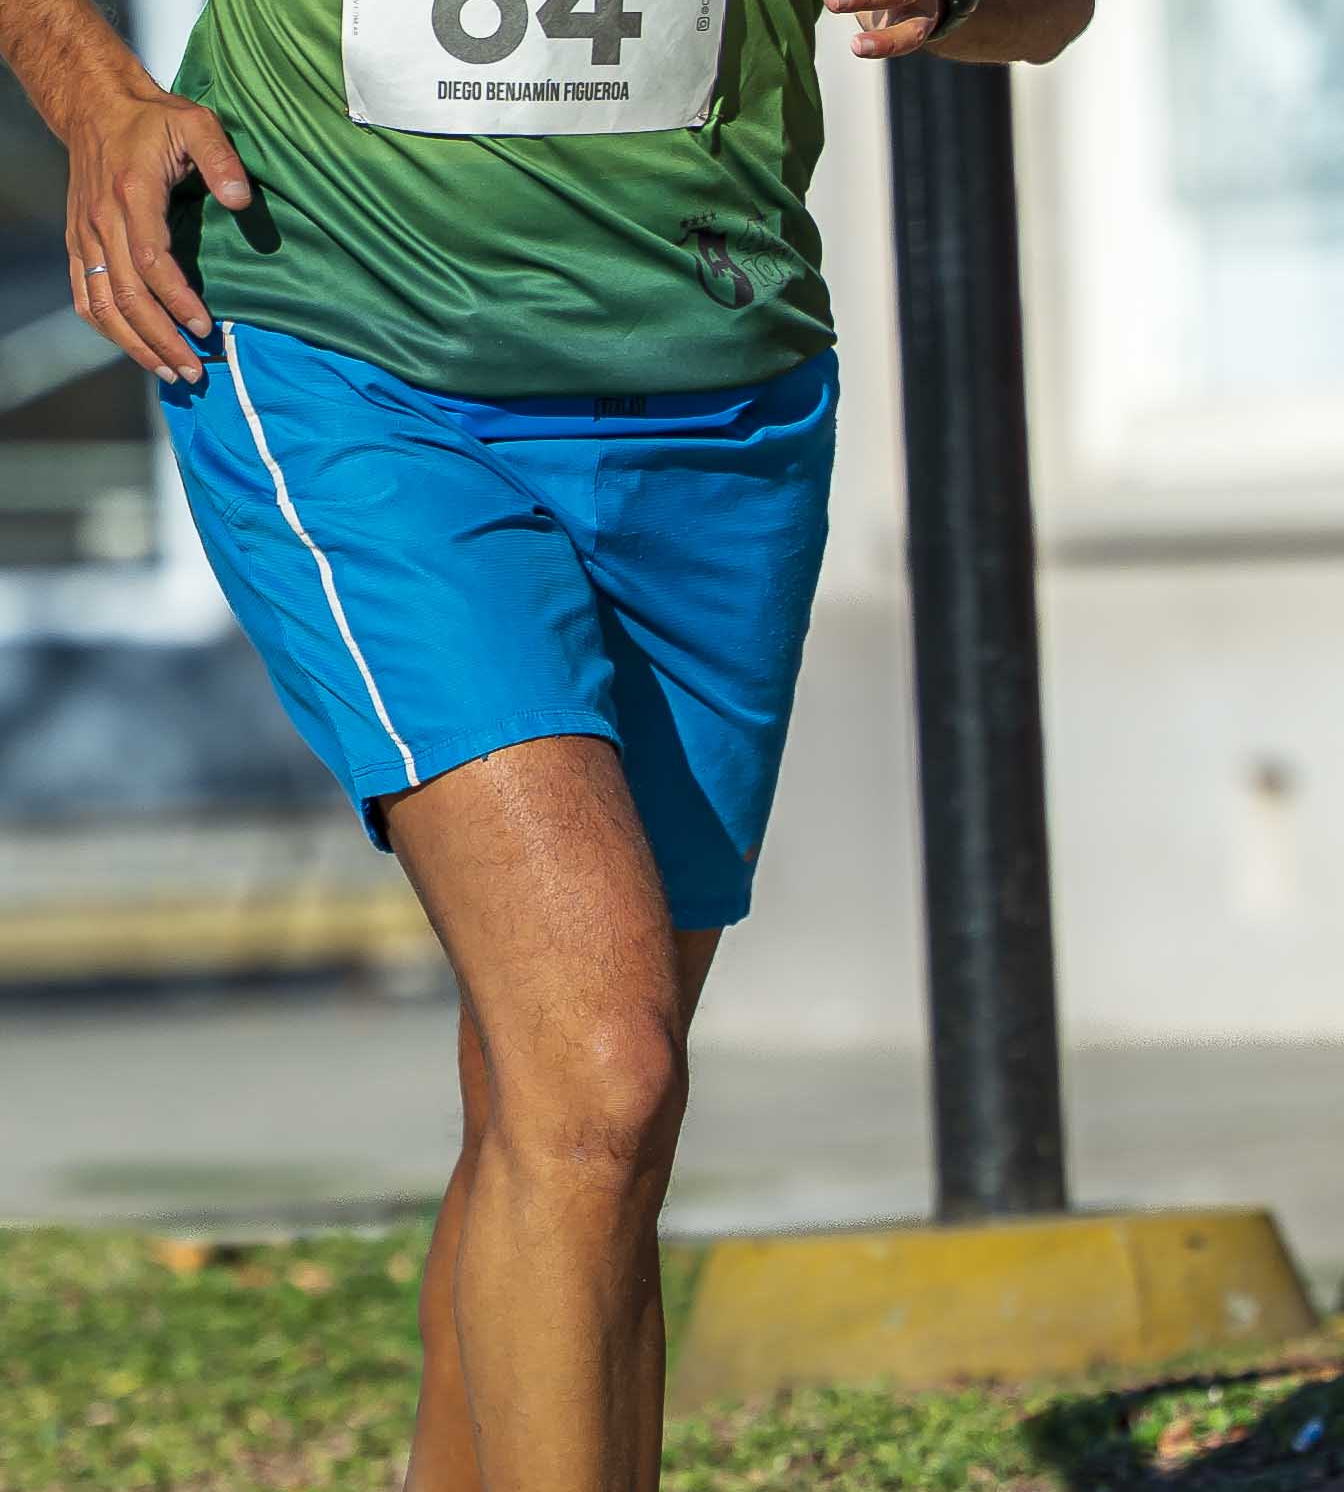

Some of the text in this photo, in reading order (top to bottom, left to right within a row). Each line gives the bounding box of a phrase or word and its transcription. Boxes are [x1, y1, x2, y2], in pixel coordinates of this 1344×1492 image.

[437, 78, 630, 103] DIEGO BENJAMÍN FIGUEROA
